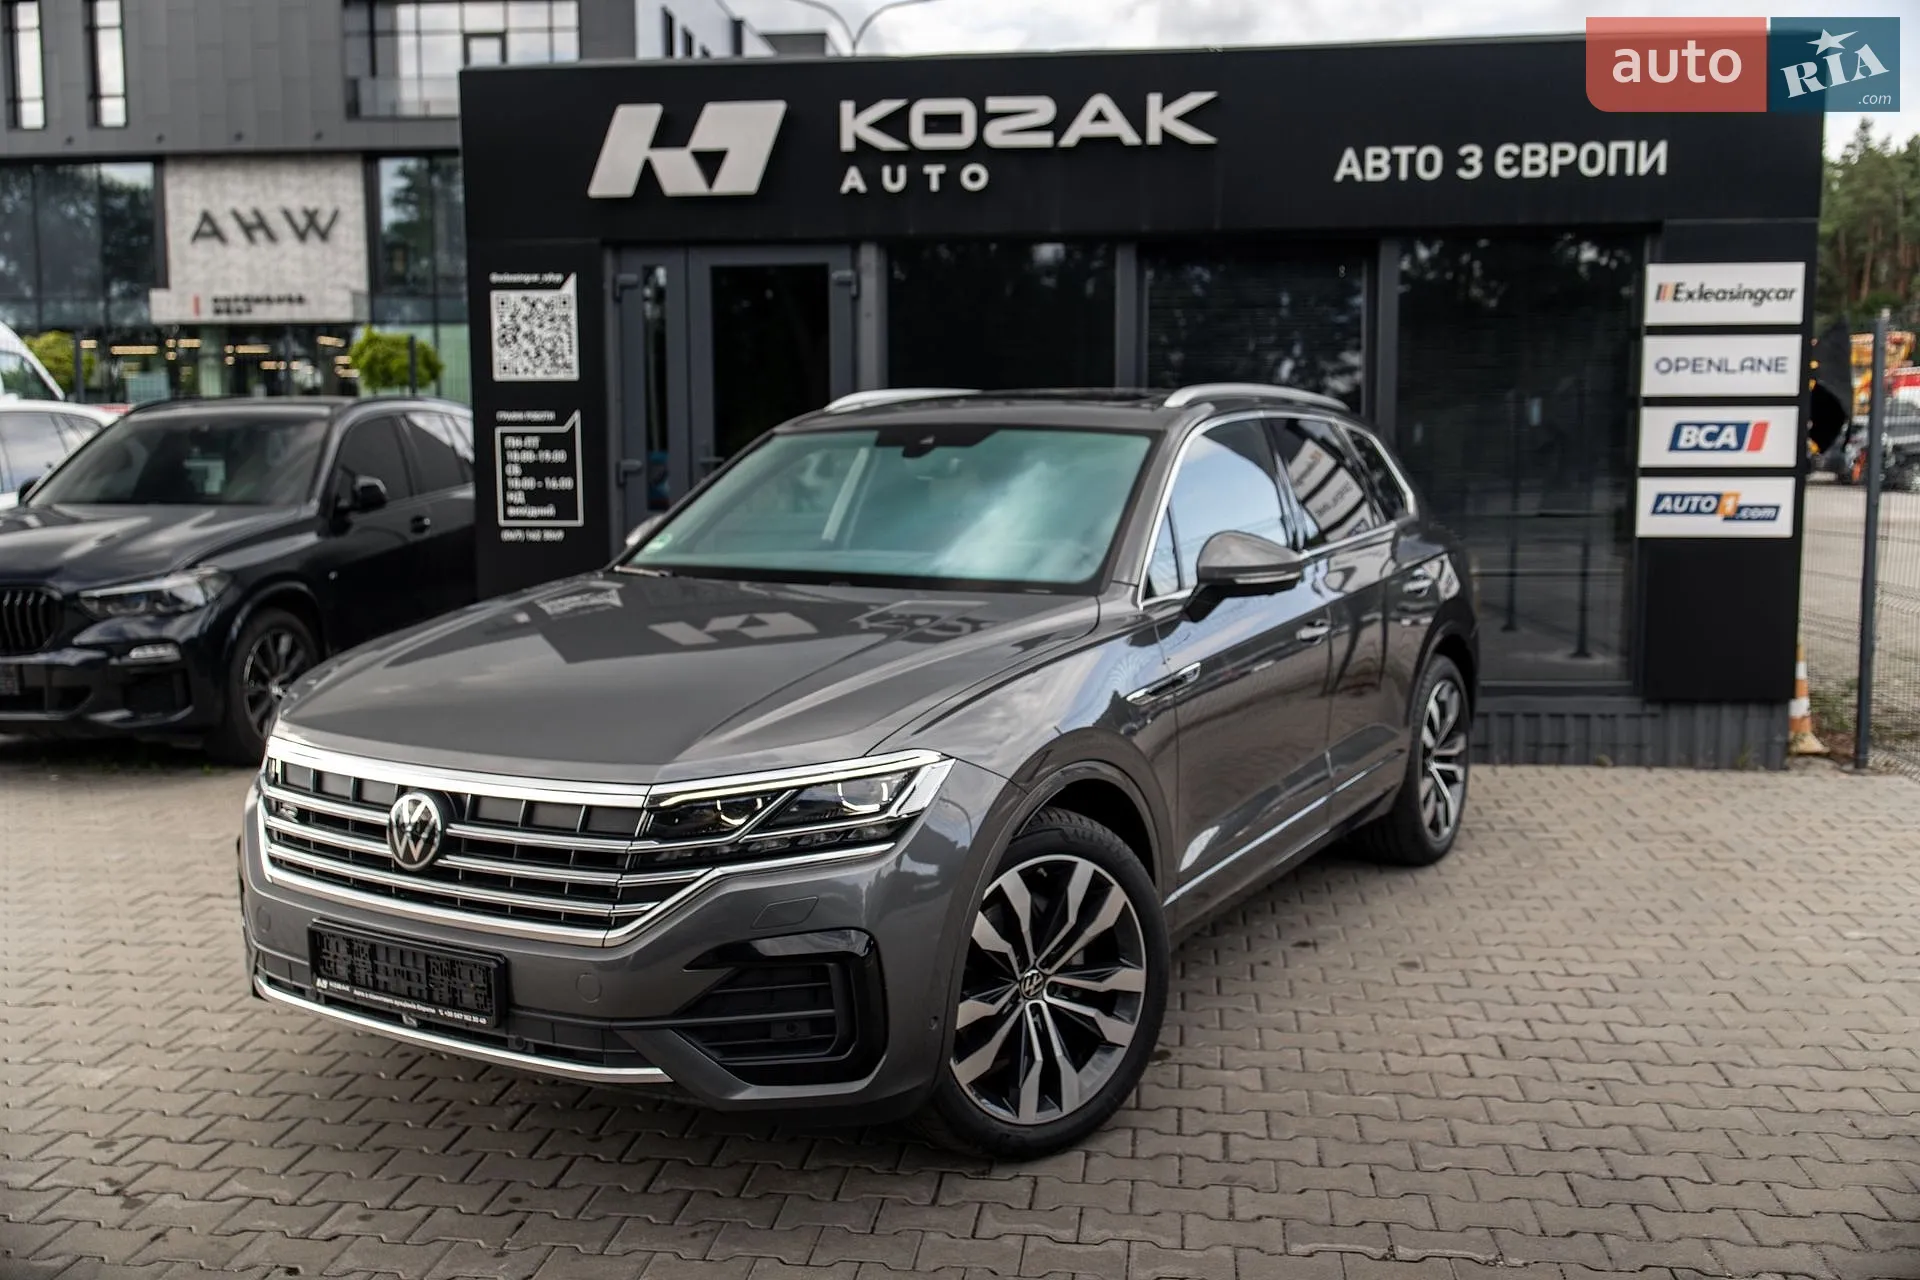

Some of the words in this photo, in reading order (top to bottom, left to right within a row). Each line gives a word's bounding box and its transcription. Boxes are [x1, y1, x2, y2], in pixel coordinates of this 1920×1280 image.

[840, 91, 1218, 152] KOZAK
[1333, 145, 1443, 182] АВТО
[1456, 143, 1483, 180] З
[1494, 139, 1669, 180] ЄВРОПИ
[840, 162, 989, 195] AUTO
[190, 206, 340, 245] AHW
[1672, 281, 1796, 307] Exleasingcar
[1654, 356, 1788, 375] OPENLANE
[1677, 424, 1739, 450] BCA
